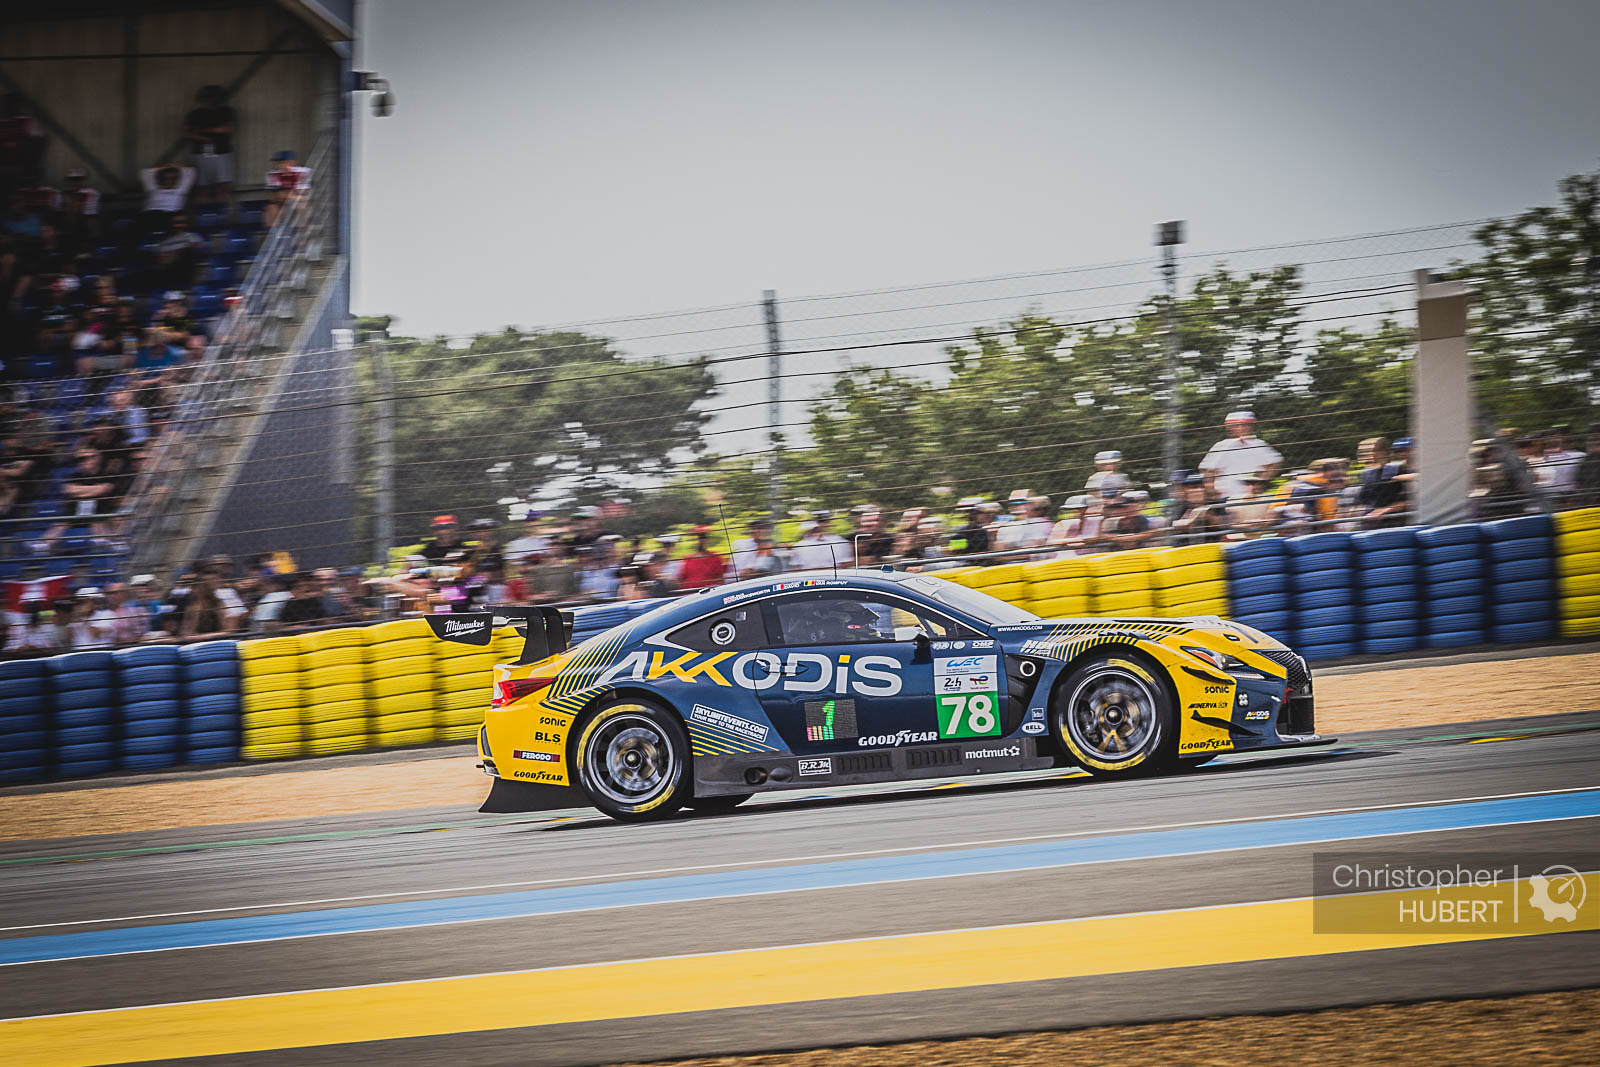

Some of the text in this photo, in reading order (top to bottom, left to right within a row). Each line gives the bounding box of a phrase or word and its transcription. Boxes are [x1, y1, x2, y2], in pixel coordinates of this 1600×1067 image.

[444, 619, 485, 633] Milwaukee
[946, 656, 985, 668] WEC
[694, 706, 766, 735] SKYLIMITEVENTS.COM
[941, 695, 995, 735] 78
[534, 731, 561, 743] BLS
[858, 729, 938, 747] GOODYEAR
[1181, 738, 1232, 750] GOODYEAR
[521, 751, 552, 761] FERODO
[965, 747, 1009, 759] matmut
[514, 770, 563, 781] GOODYEAR
